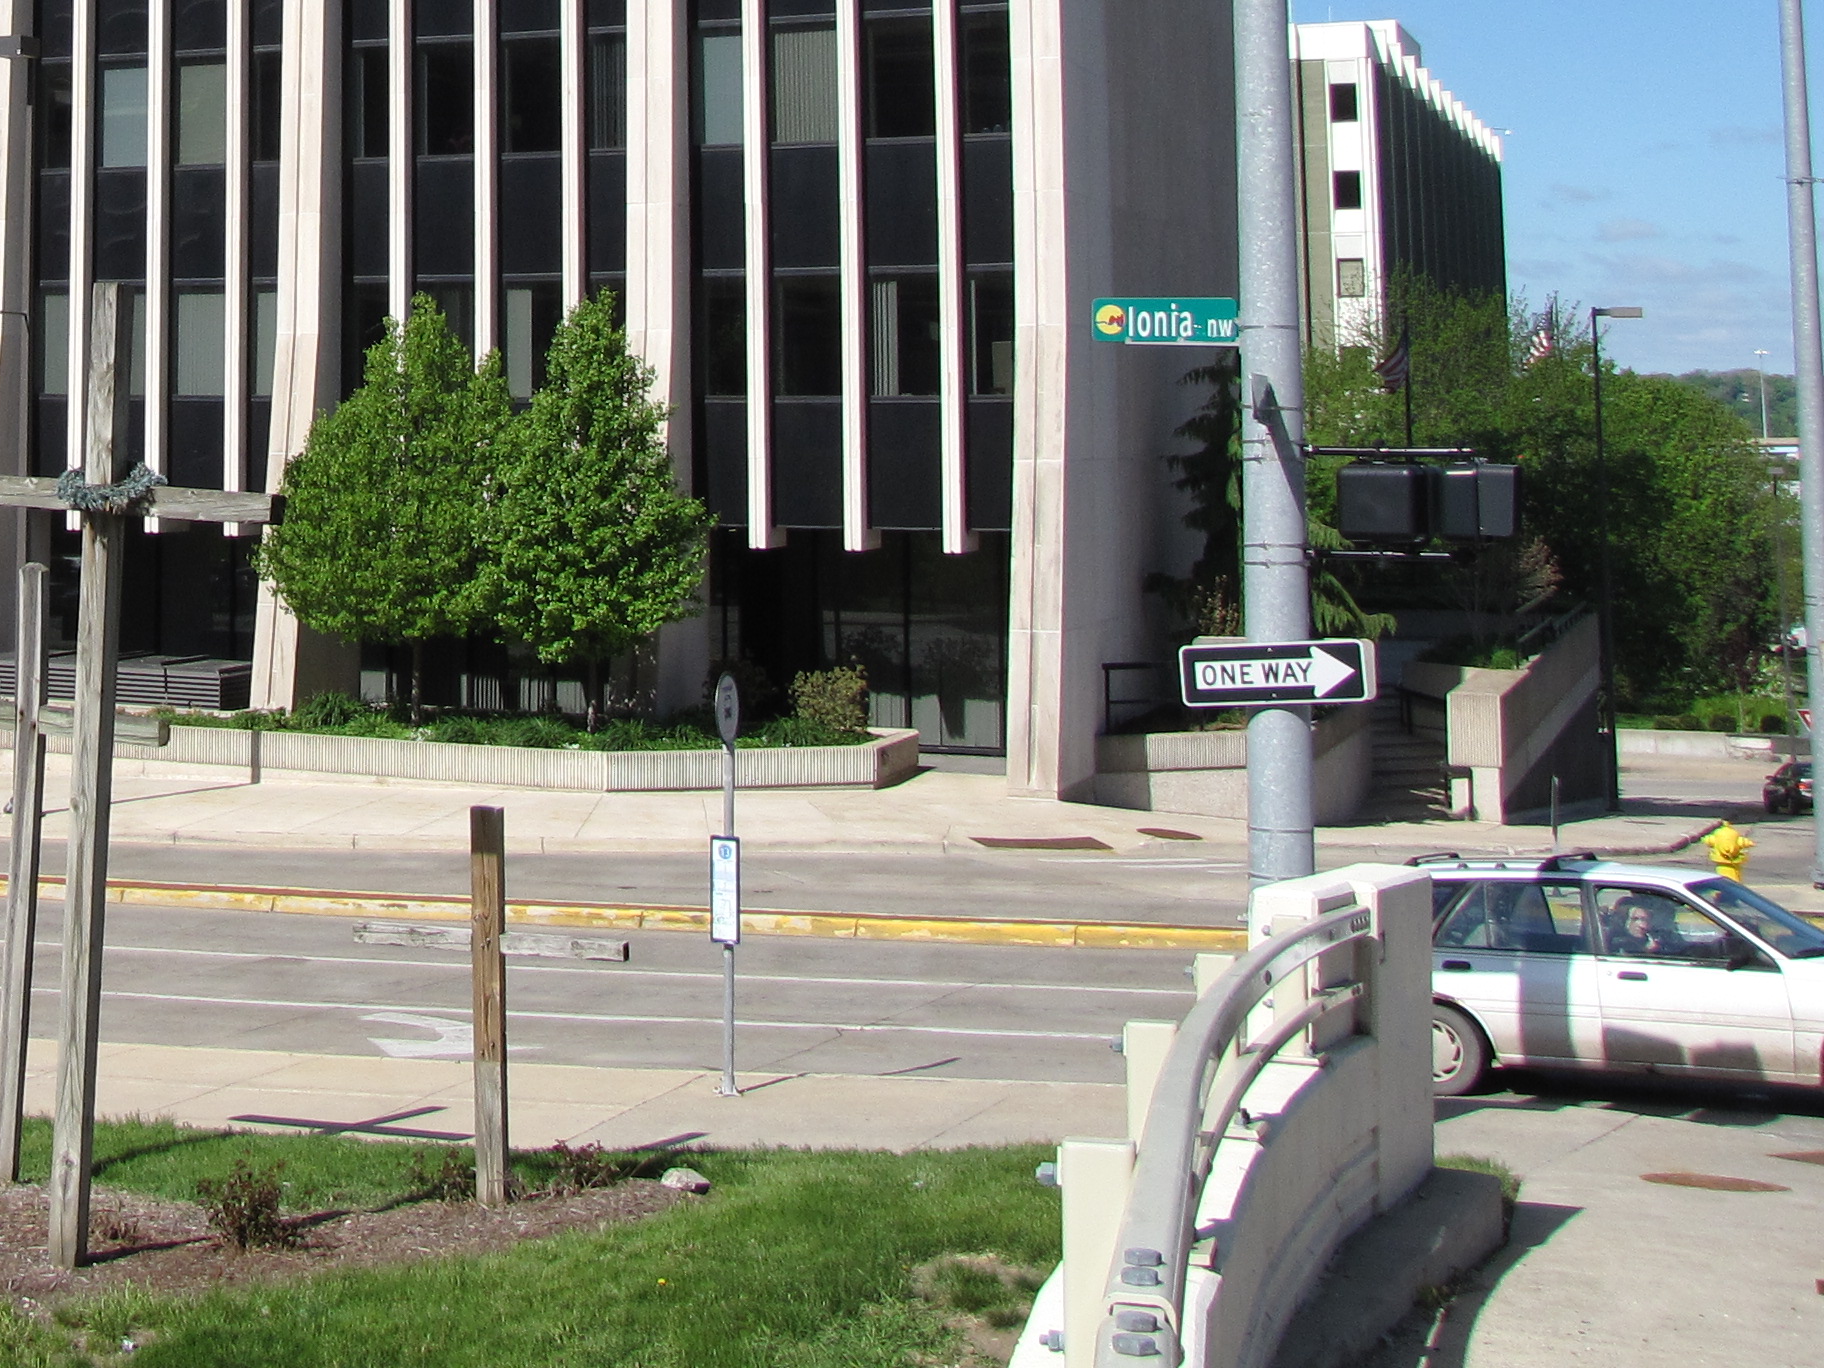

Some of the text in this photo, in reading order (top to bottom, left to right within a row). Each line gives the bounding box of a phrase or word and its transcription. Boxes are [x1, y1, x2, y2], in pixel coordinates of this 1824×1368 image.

[1128, 303, 1193, 337] Ionia
[1202, 661, 1313, 686] ONE WAY
